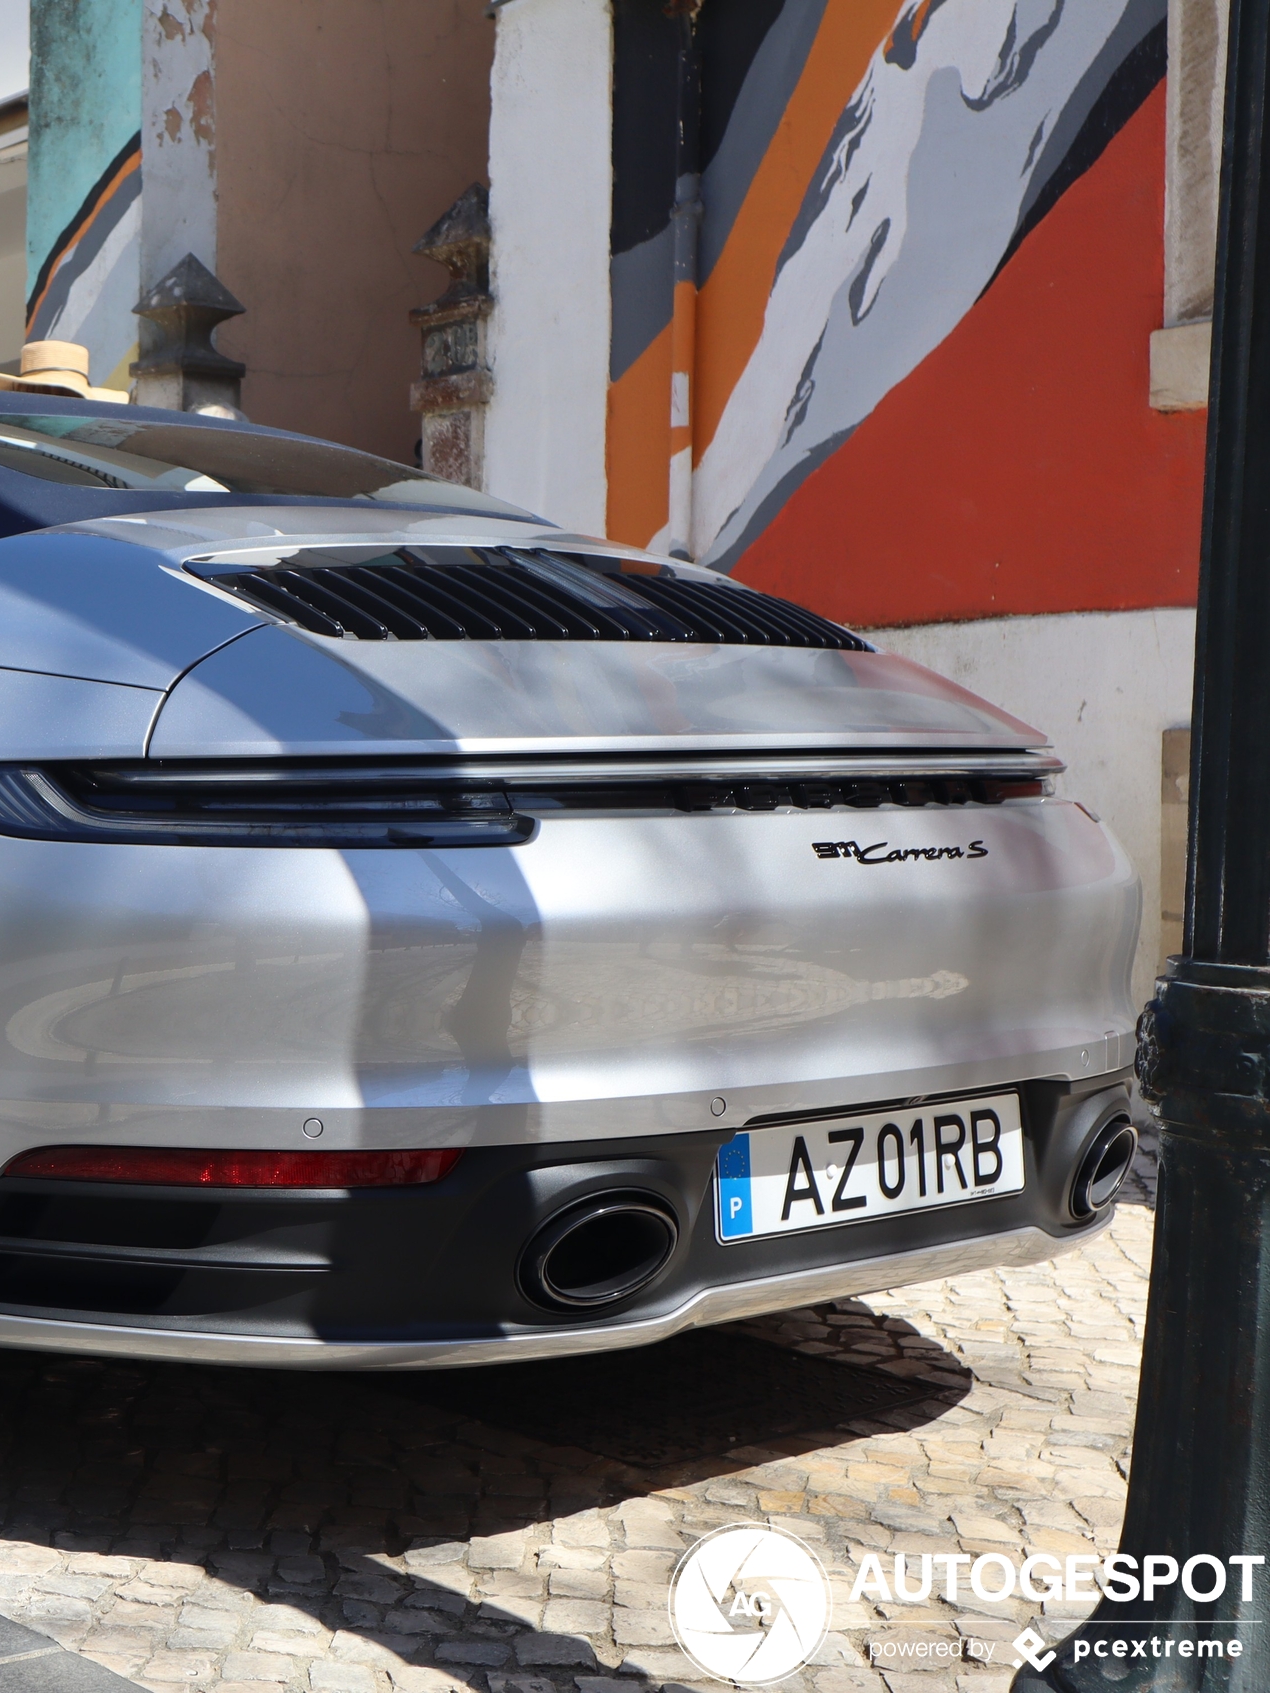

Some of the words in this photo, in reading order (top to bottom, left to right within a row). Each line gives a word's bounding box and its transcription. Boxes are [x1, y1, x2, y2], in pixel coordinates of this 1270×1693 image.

[856, 842, 965, 864] Carrera
[967, 840, 989, 859] S
[730, 1196, 743, 1219] P
